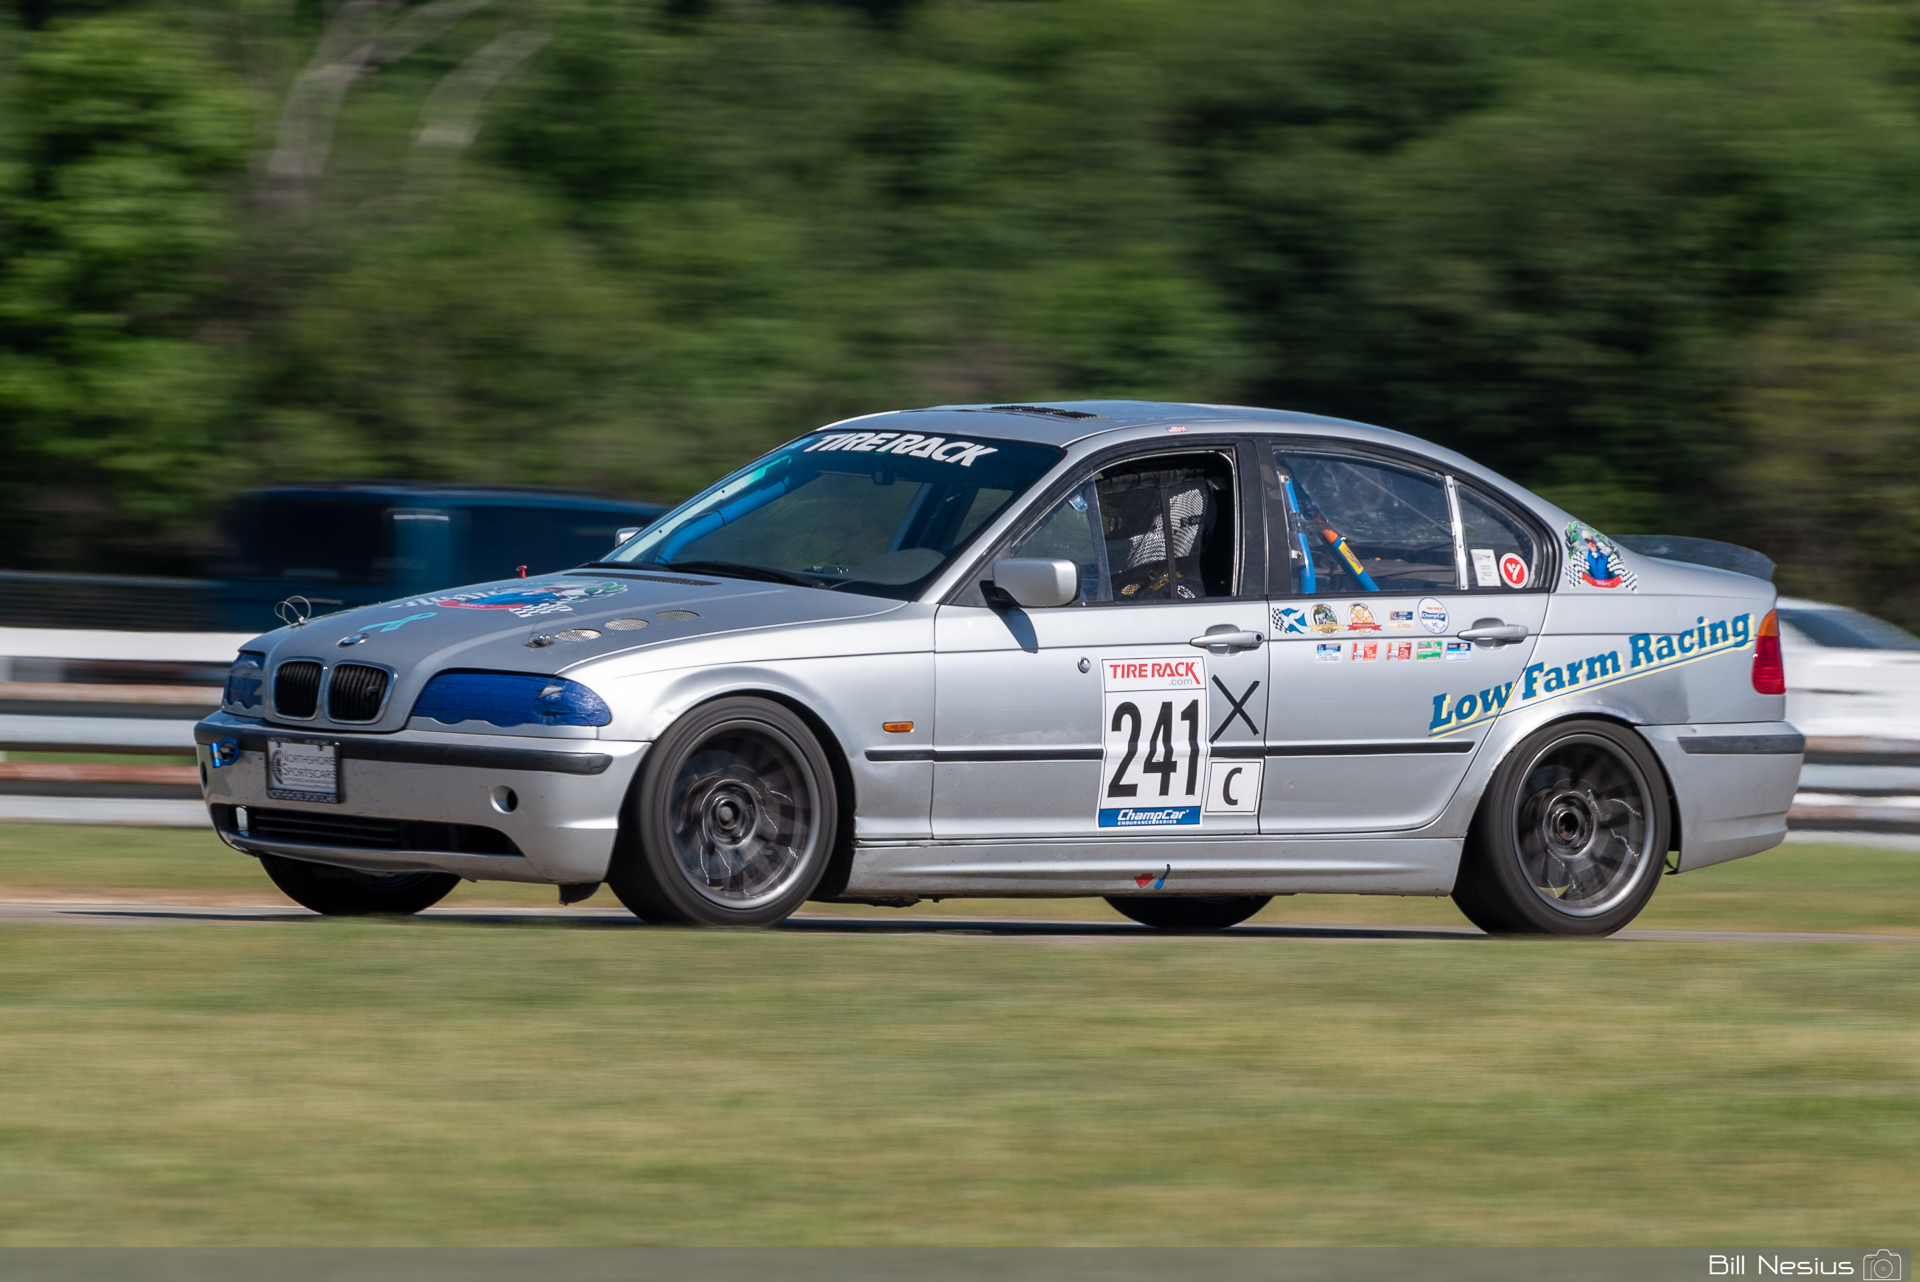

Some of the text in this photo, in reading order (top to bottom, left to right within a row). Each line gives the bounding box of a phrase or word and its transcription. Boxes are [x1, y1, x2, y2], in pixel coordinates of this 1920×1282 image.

[803, 432, 998, 467] TIRE RACK
[1109, 661, 1201, 685] TIRE RACK
[1168, 678, 1193, 686] .com
[1429, 612, 1757, 733] Low Farm Racing
[1107, 699, 1200, 798] 241
[1222, 767, 1243, 806] C
[1117, 809, 1187, 824] ChampCar
